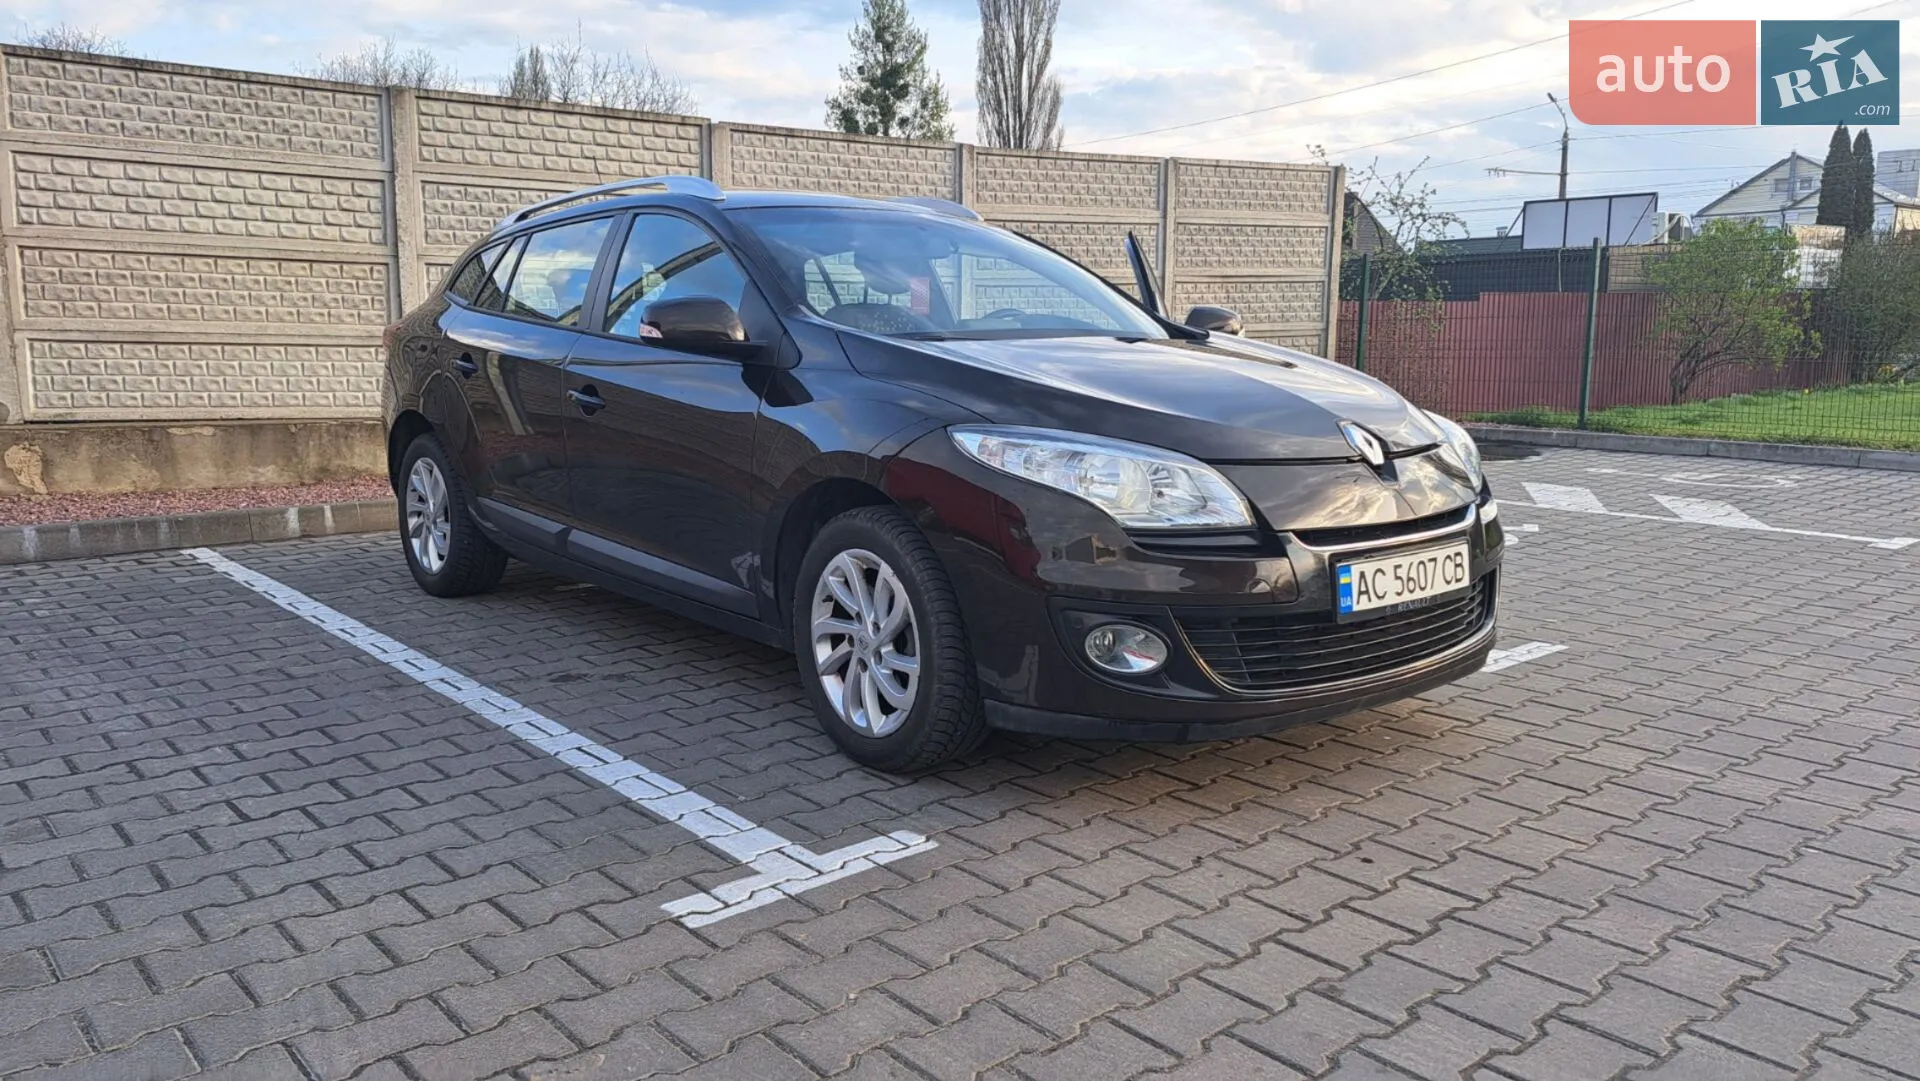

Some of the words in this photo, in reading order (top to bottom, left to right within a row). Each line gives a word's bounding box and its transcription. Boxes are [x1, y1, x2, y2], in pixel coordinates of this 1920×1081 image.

[1356, 568, 1387, 605] AC
[1393, 557, 1438, 596] 5607
[1442, 551, 1465, 586] CB
[1340, 596, 1352, 608] UA
